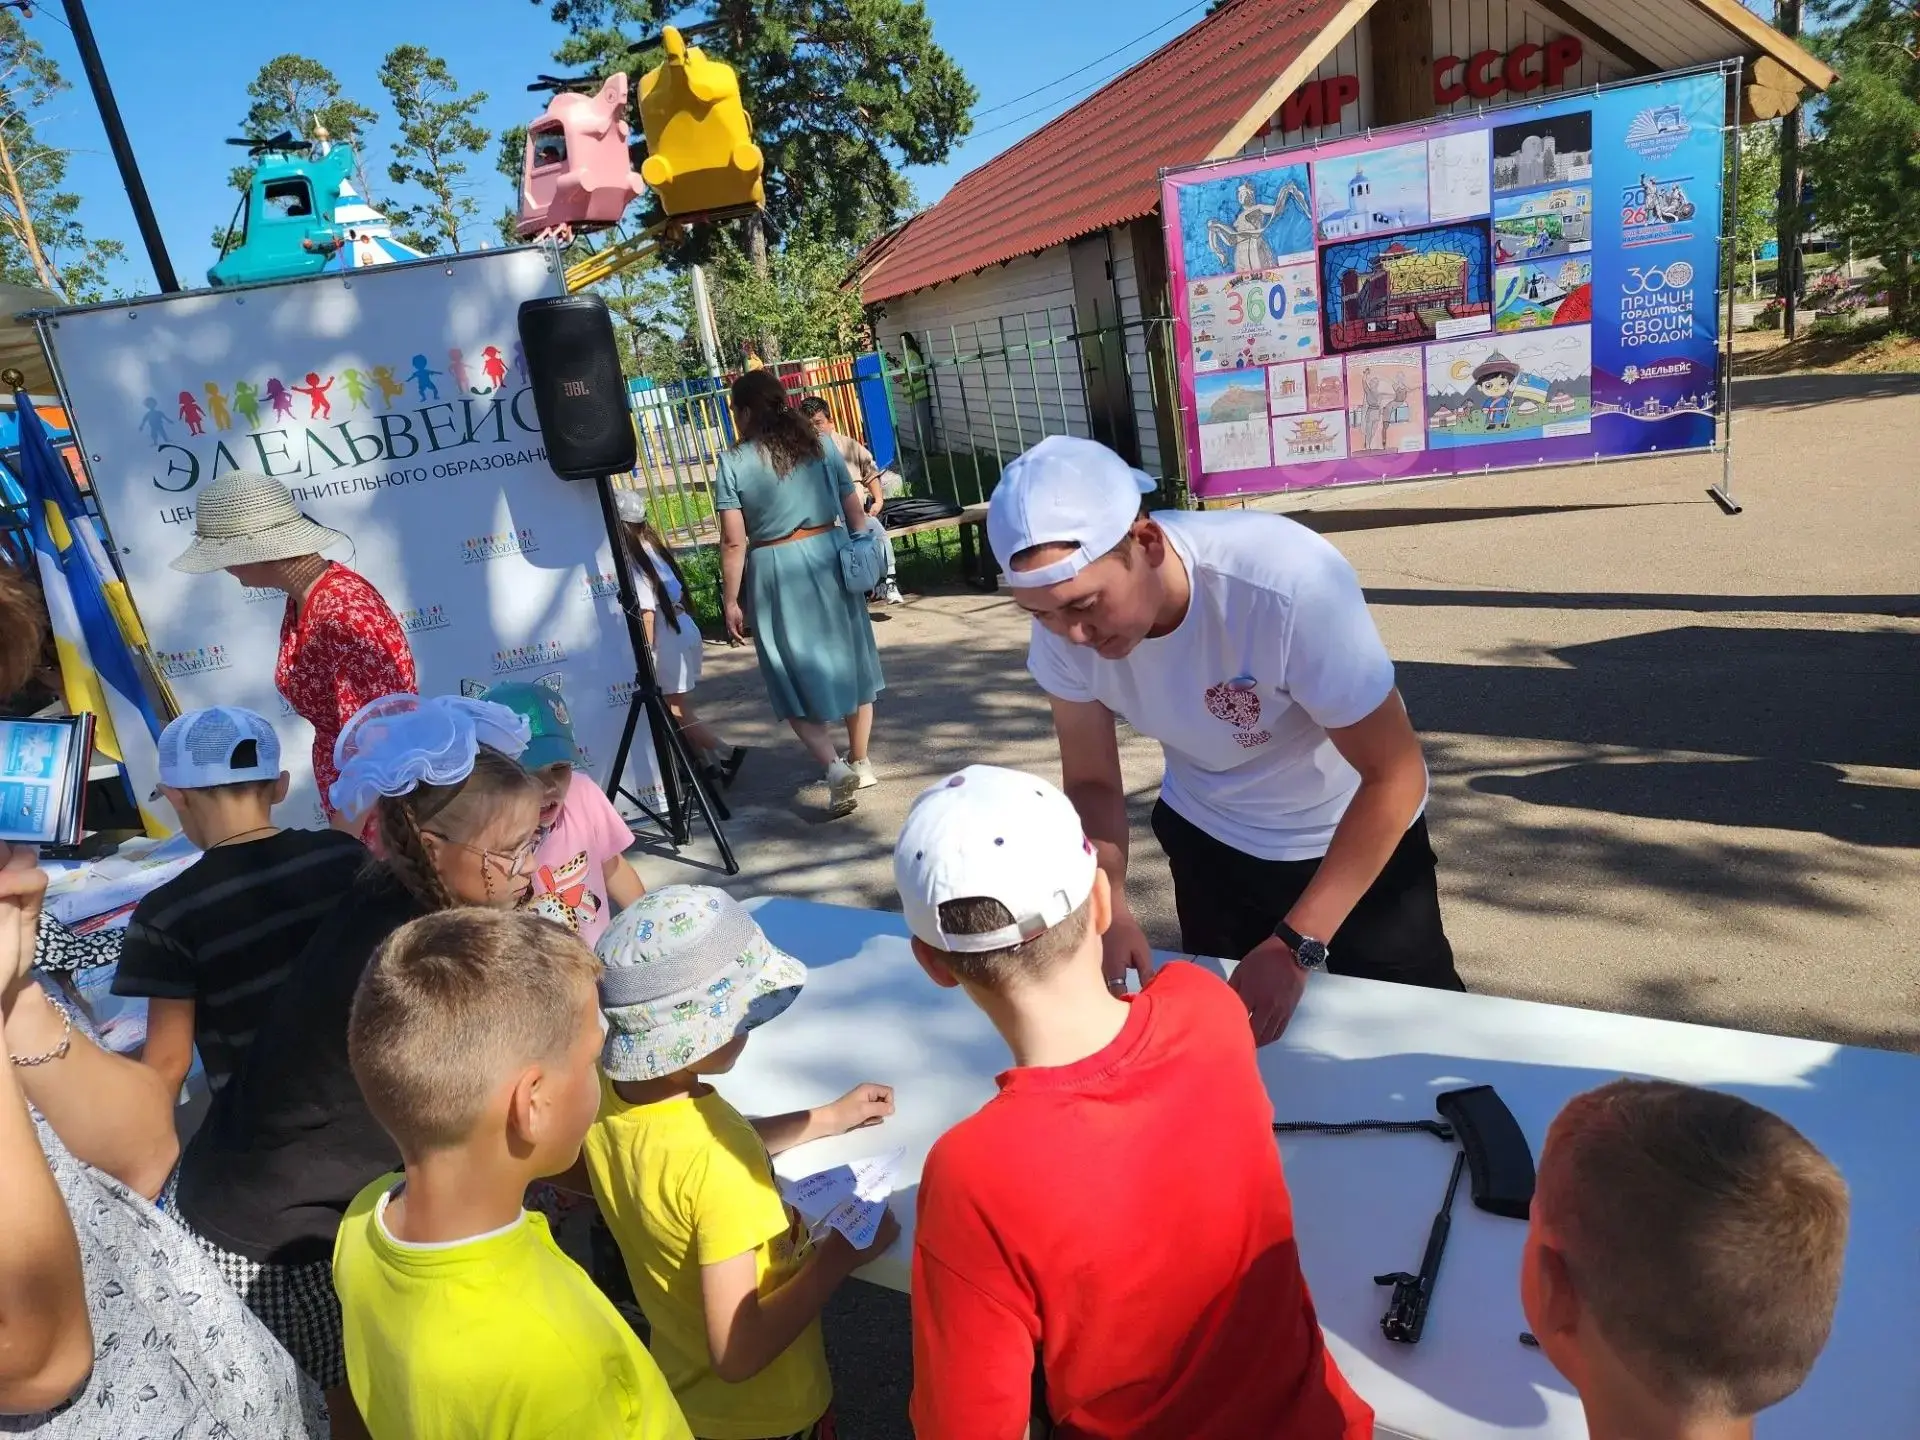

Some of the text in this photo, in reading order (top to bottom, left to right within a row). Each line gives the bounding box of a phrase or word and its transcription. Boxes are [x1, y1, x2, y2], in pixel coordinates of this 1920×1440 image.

[1433, 35, 1583, 105] СССР
[1622, 190, 1646, 208] 20
[1622, 207, 1646, 225] 26
[1622, 261, 1694, 294] 360
[1227, 284, 1286, 325] 360
[1622, 314, 1692, 335] СВОИМ
[1621, 328, 1692, 347] ГОРОДОМ
[1640, 362, 1691, 376] ЭДЕЛЬВЕЙС
[563, 381, 590, 397] JBL
[160, 447, 551, 525] ЦЕН ЛНИТЕЛЬНОГО ОБРАЗОВАНИ
